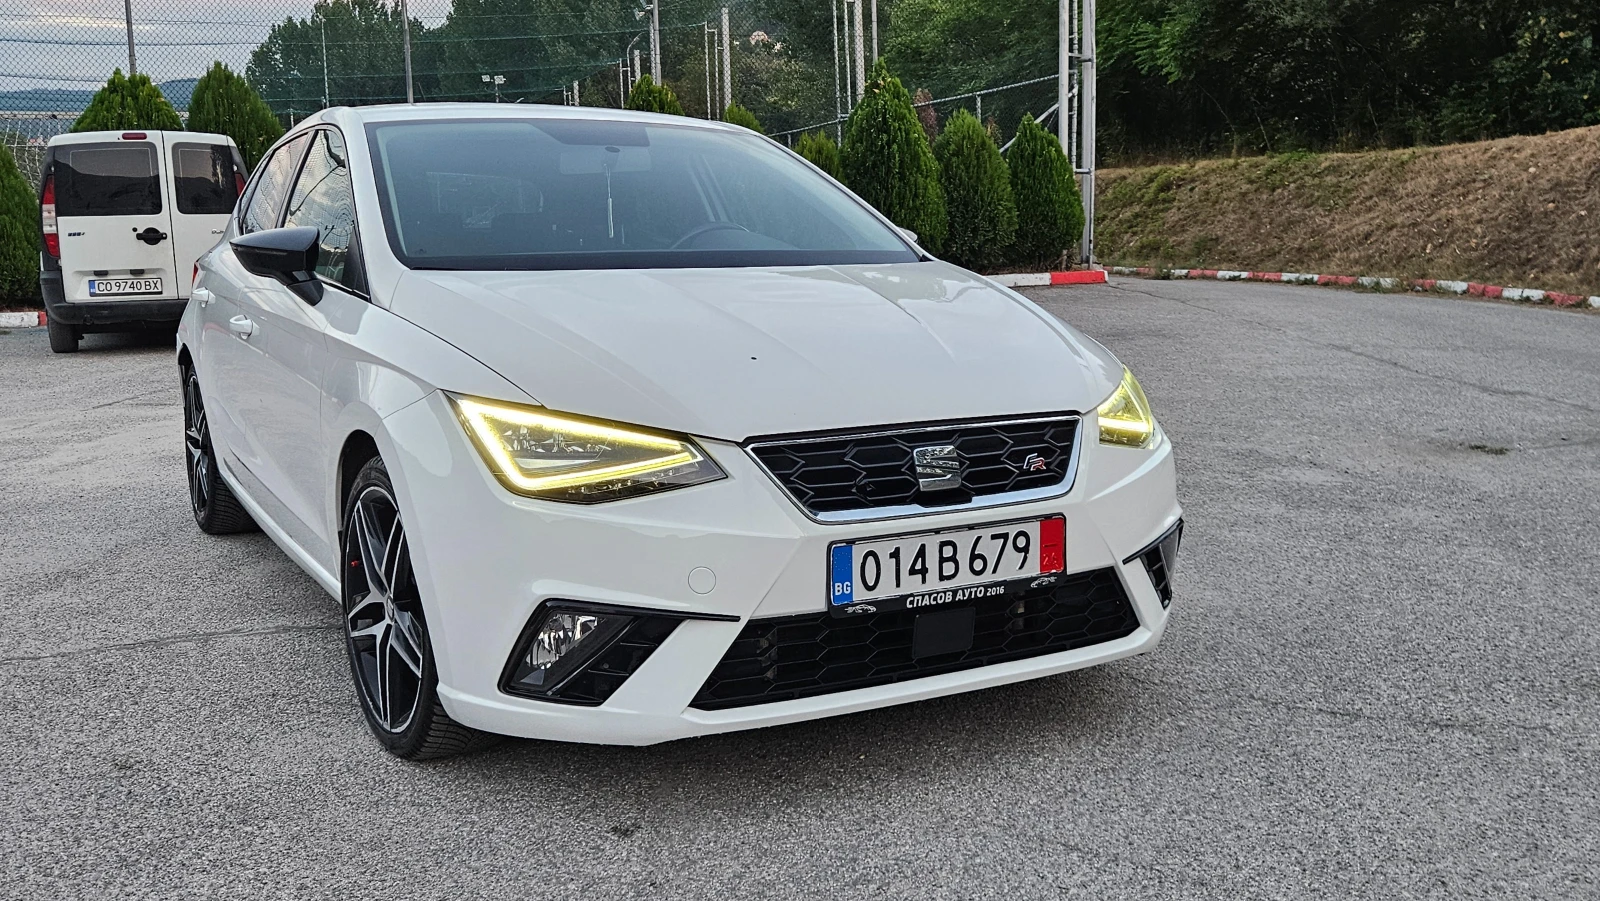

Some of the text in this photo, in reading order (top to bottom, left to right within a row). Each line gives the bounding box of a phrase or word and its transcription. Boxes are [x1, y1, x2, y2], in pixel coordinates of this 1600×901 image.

[97, 281, 113, 292] CO
[114, 280, 142, 291] 9740
[144, 279, 160, 290] BX
[1023, 452, 1047, 472] FR
[834, 581, 851, 596] BG
[906, 585, 1005, 608] СПАСОВ АУТО 2016
